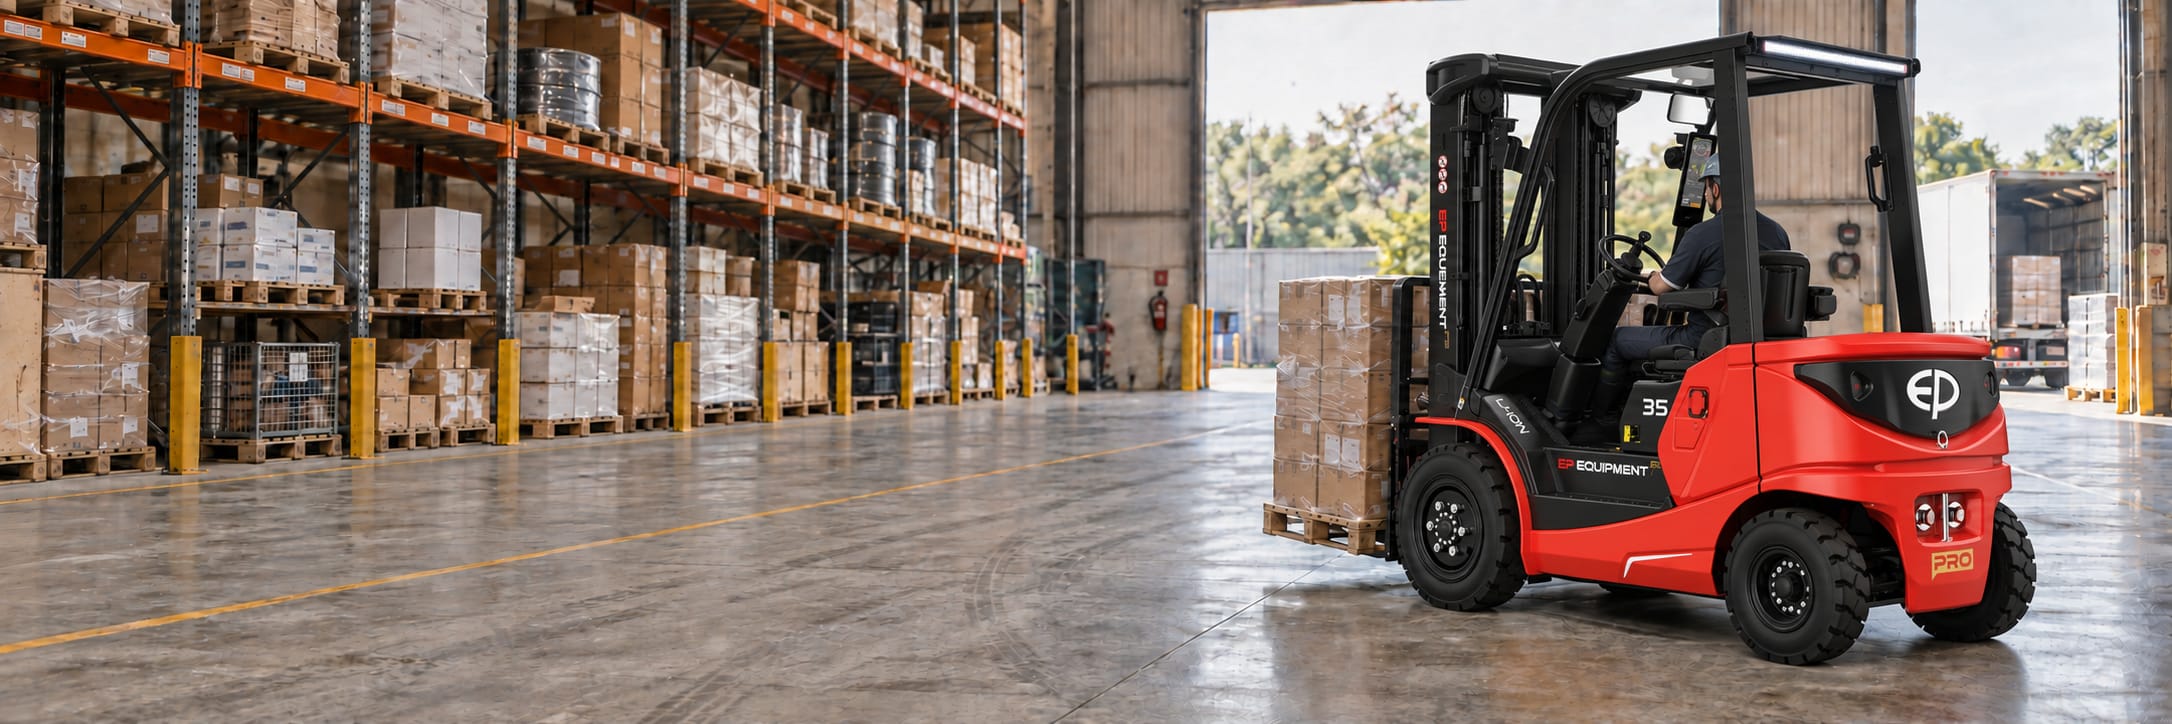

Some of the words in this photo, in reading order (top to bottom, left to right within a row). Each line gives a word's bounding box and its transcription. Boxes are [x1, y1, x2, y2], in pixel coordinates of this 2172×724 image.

[1438, 209, 1447, 232] EP
[1906, 368, 1960, 420] EP
[1642, 398, 1668, 416] 35
[1557, 458, 1575, 470] EP
[1576, 460, 1649, 477] EQUIPMENT
[1934, 551, 1972, 571] PRO
